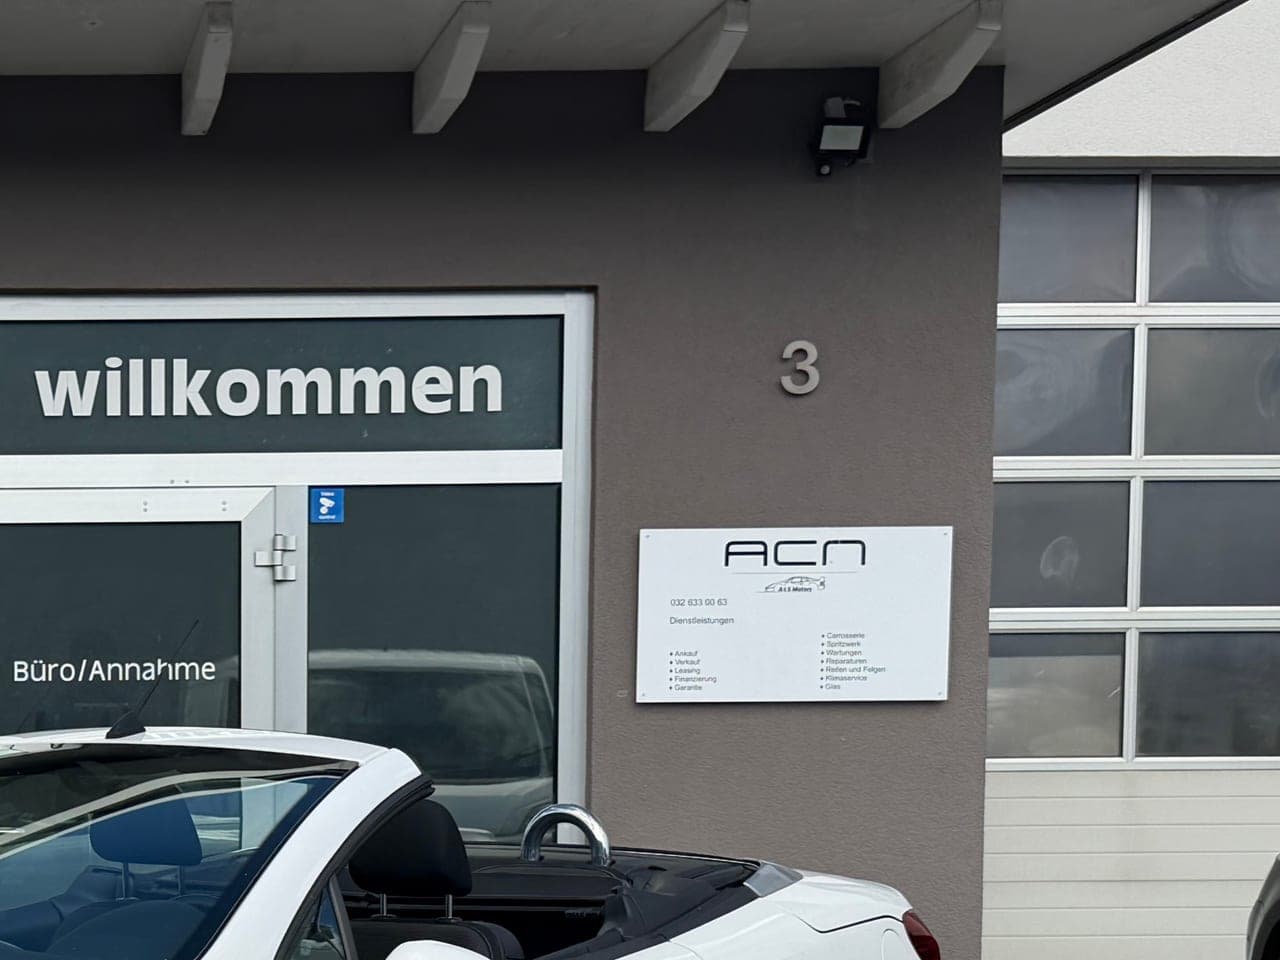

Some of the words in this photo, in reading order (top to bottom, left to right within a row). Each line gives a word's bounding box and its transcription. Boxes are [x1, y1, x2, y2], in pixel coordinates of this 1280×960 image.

[780, 339, 821, 396] 3
[34, 356, 504, 417] willkommen
[670, 598, 686, 607] 032
[717, 598, 728, 607] 63
[669, 616, 735, 626] Dienstleistungen
[826, 632, 866, 640] Carrosserie
[826, 640, 861, 649] Spritzwerk
[825, 649, 862, 658] Wartungen
[825, 657, 867, 666] Reparaturen
[13, 658, 216, 682] Büro/Annahme
[674, 666, 701, 675] Leasing
[848, 666, 862, 674] und
[674, 674, 717, 683] Finanzierung
[825, 674, 868, 682] Klimaservice
[674, 683, 703, 691] Garantie
